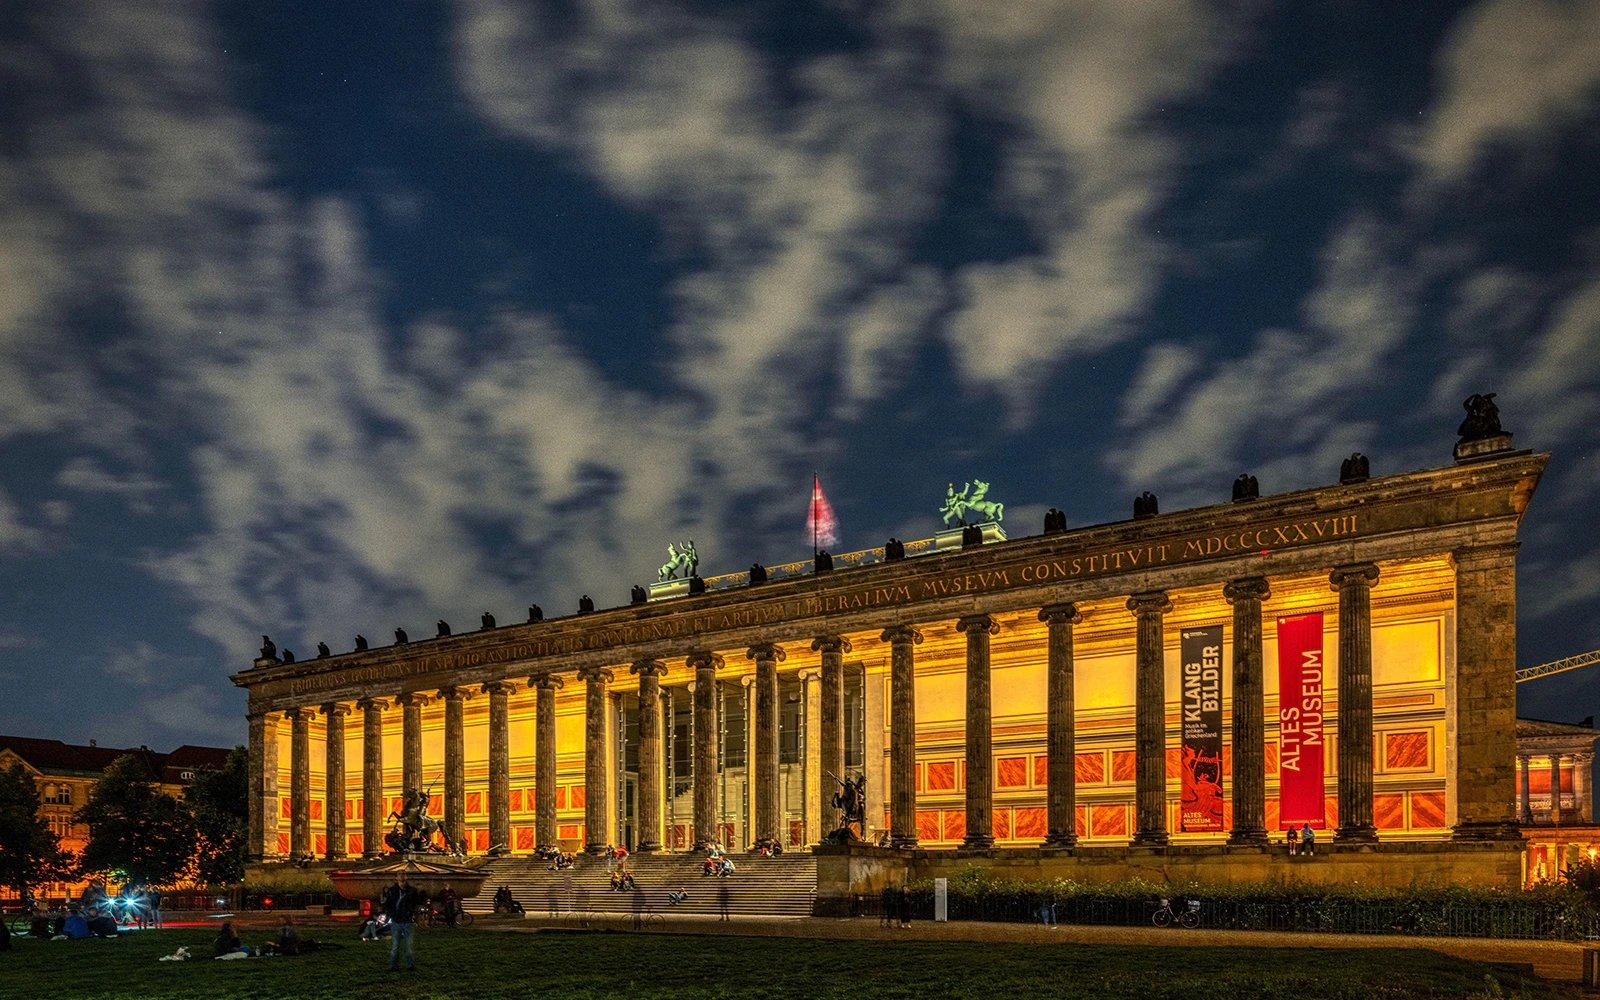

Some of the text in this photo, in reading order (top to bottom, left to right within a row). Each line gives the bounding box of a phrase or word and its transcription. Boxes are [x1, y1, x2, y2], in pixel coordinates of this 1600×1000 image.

[720, 606, 788, 628] ARTIVM
[795, 585, 911, 616] LIBERALIVM
[922, 570, 1010, 597] MVSEVM
[1021, 544, 1171, 582] CONSTITVIT
[1183, 515, 1358, 559] MDCCCXXVIII
[1184, 662, 1201, 721] KLANG
[1202, 645, 1219, 712] BILDER
[1302, 650, 1322, 745] MUSEUM
[1281, 707, 1300, 772] ALTES
